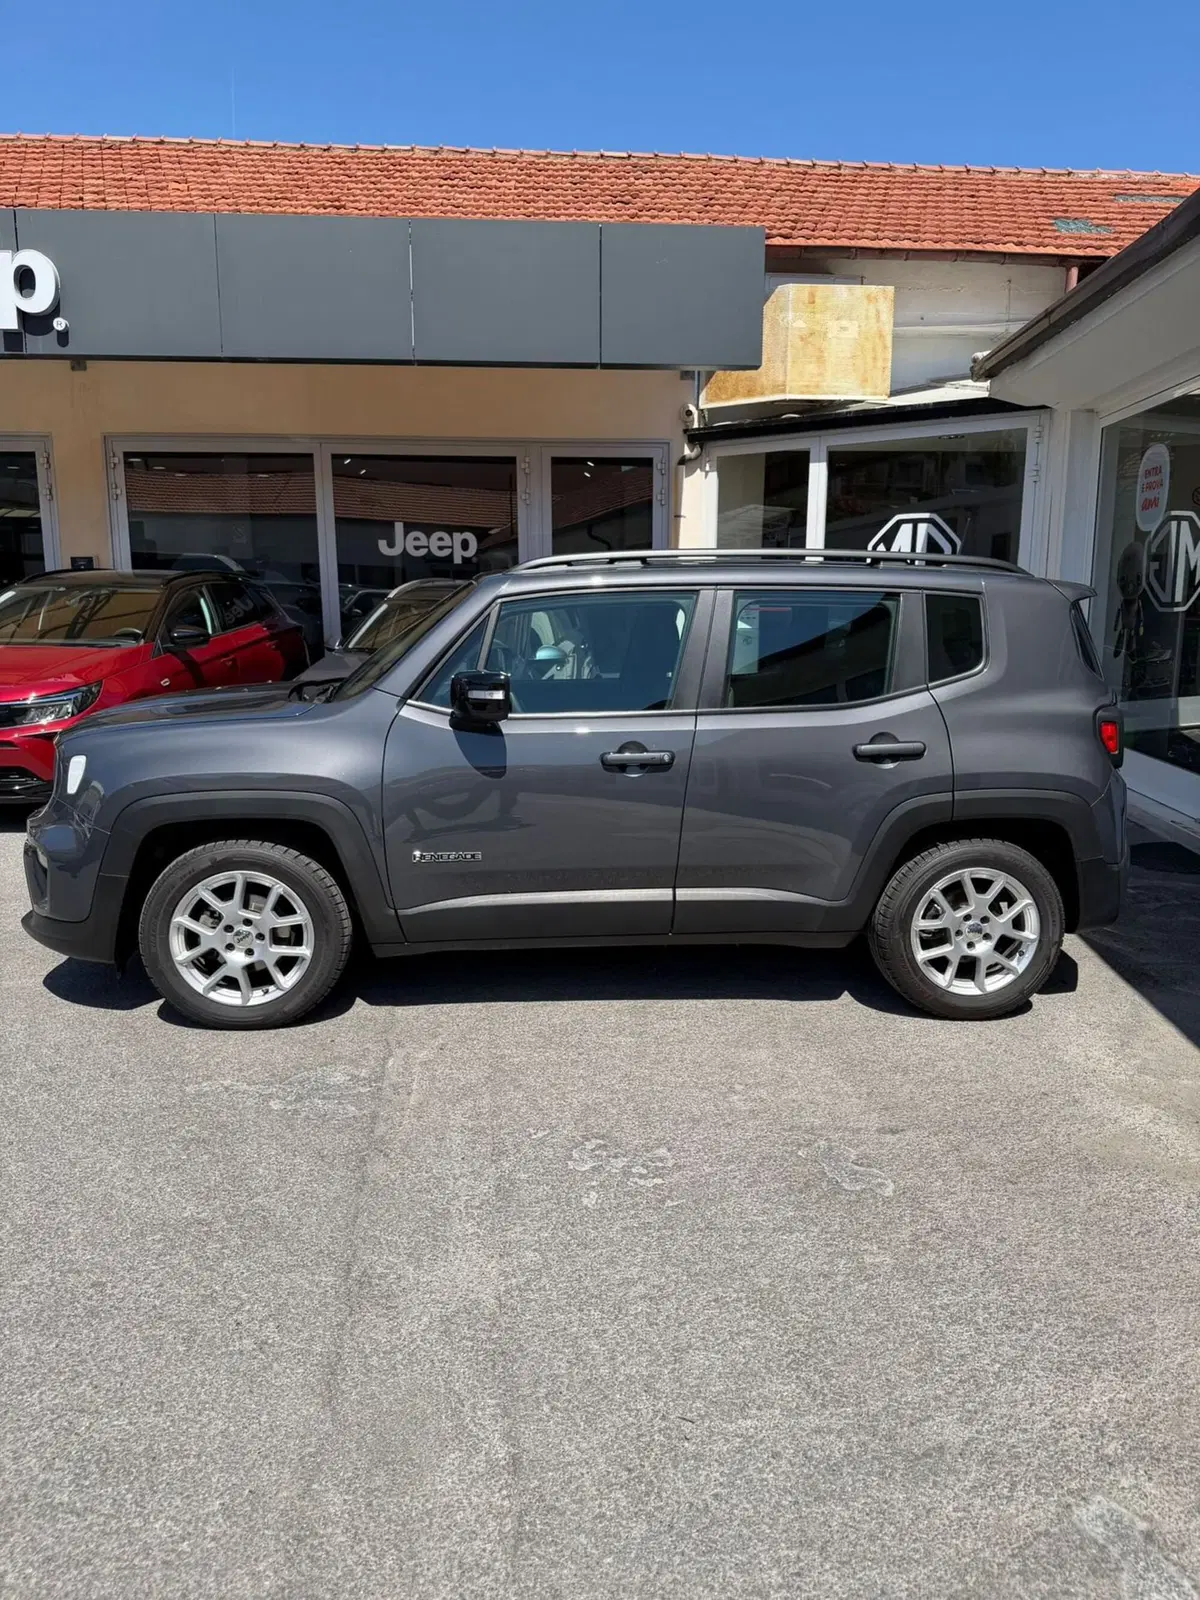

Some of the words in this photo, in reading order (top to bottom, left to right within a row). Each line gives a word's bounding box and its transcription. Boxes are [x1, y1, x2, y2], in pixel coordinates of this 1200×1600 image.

[1144, 466, 1162, 479] ENTRA
[378, 521, 478, 564] Jeep
[412, 849, 482, 863] RENEGADE
